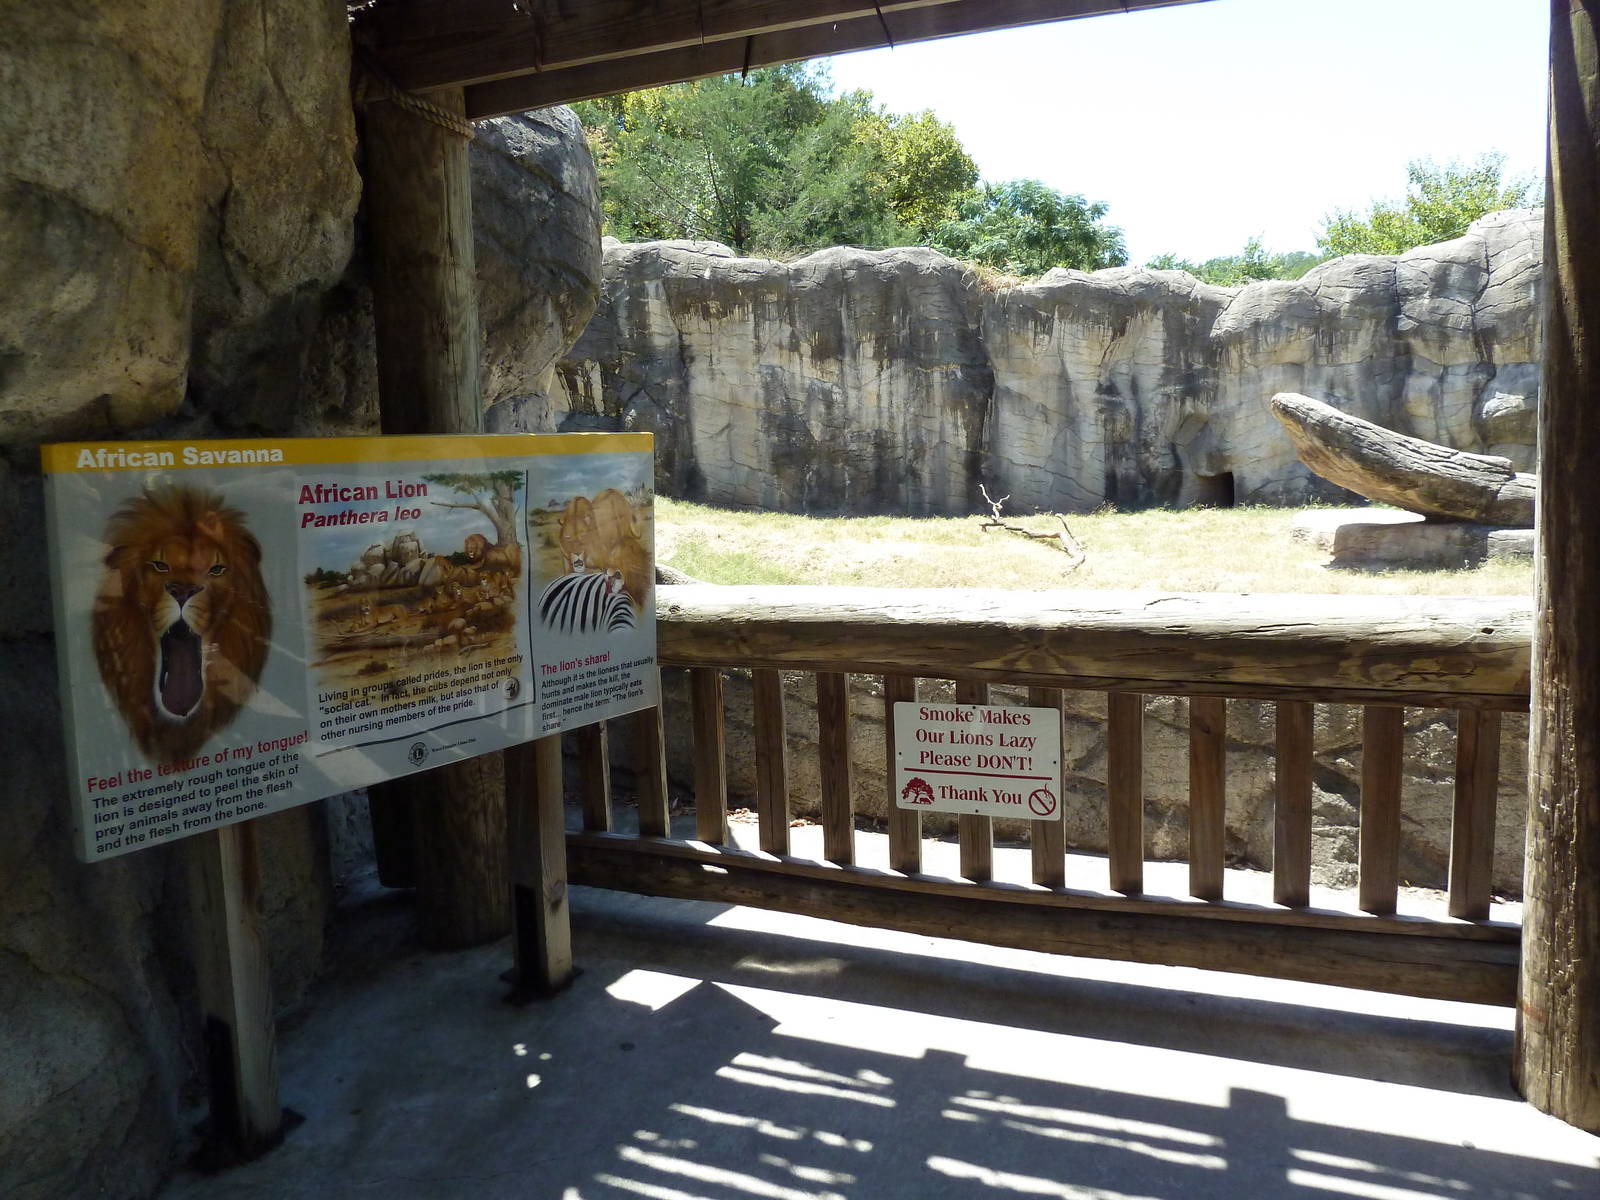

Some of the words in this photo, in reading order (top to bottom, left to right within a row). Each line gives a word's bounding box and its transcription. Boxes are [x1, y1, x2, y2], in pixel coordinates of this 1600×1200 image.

[76, 448, 175, 468] African
[182, 446, 284, 466] Savanna
[299, 484, 378, 504] African
[386, 480, 427, 498] Lion
[301, 510, 388, 528] Panthera
[395, 506, 421, 520] leo
[319, 689, 348, 703] Living
[351, 688, 360, 696] in
[362, 681, 394, 695] groups
[396, 677, 422, 690] called
[424, 670, 451, 684] prides,
[454, 665, 466, 674] the
[468, 662, 483, 672] lion
[494, 658, 506, 666] the
[508, 653, 523, 664] only
[541, 664, 557, 676] The
[560, 658, 582, 671] lion's
[585, 651, 610, 666] share!
[541, 676, 571, 688] Although
[586, 670, 596, 678] the
[598, 666, 619, 676] lioness
[621, 661, 632, 670] that
[634, 656, 654, 667] usually
[319, 703, 352, 715] "social
[381, 694, 390, 702] In
[412, 686, 426, 695] the
[428, 678, 448, 691] cubs
[451, 673, 479, 688] depend
[482, 670, 494, 680] not
[496, 667, 512, 677] only
[541, 698, 572, 711] dominate
[574, 691, 589, 701] male
[591, 689, 602, 698] lion
[603, 682, 628, 696] typically
[542, 689, 560, 699] hunts
[576, 681, 596, 691] makes
[621, 672, 630, 680] the
[320, 720, 332, 729] on
[335, 713, 356, 724] their
[359, 710, 377, 719] own
[381, 702, 416, 715] mothers
[419, 696, 438, 707] milk,
[441, 692, 454, 703] but
[456, 687, 472, 698] also
[475, 684, 487, 694] that
[490, 680, 499, 689] of
[563, 704, 582, 715] hence
[584, 702, 593, 710] the
[628, 688, 643, 698] lion's
[919, 707, 974, 722] Smoke
[980, 710, 1031, 725] Makes
[321, 728, 345, 741] other
[349, 720, 383, 735] nursing
[386, 711, 426, 726] members
[428, 707, 436, 716] of
[439, 703, 451, 712] the
[453, 699, 475, 712] pride.
[916, 729, 944, 743] Our
[950, 730, 993, 746] Lions
[1000, 733, 1036, 750] Lazy
[88, 772, 122, 792] Feel
[128, 766, 152, 784] the
[157, 754, 210, 776] texture
[215, 748, 229, 763] of
[232, 744, 253, 760] my
[258, 730, 309, 754] tongue!
[920, 751, 971, 767] Please
[977, 754, 1032, 770] DON'T!
[92, 796, 118, 809] The
[122, 779, 184, 802] extremely
[188, 770, 222, 787] rough
[226, 761, 265, 777] tongue
[269, 756, 280, 766] of
[283, 752, 299, 763] the
[94, 811, 119, 824] lion
[124, 808, 134, 817] is
[138, 793, 196, 813] designed
[199, 788, 211, 797] to
[215, 780, 238, 798] peel
[242, 774, 259, 786] the
[262, 768, 285, 782] skin
[288, 765, 299, 775] of
[938, 785, 988, 802] Thank
[992, 789, 1022, 804] You
[96, 824, 124, 841] prey
[129, 810, 178, 830] animals
[182, 802, 212, 816] away
[216, 793, 242, 807] from
[246, 786, 263, 797] the
[266, 780, 293, 793] flesh
[97, 839, 121, 853] and
[125, 833, 145, 845] the
[150, 824, 179, 839] flesh
[184, 816, 211, 829] from
[215, 809, 232, 822] the
[236, 802, 267, 816] bone.
